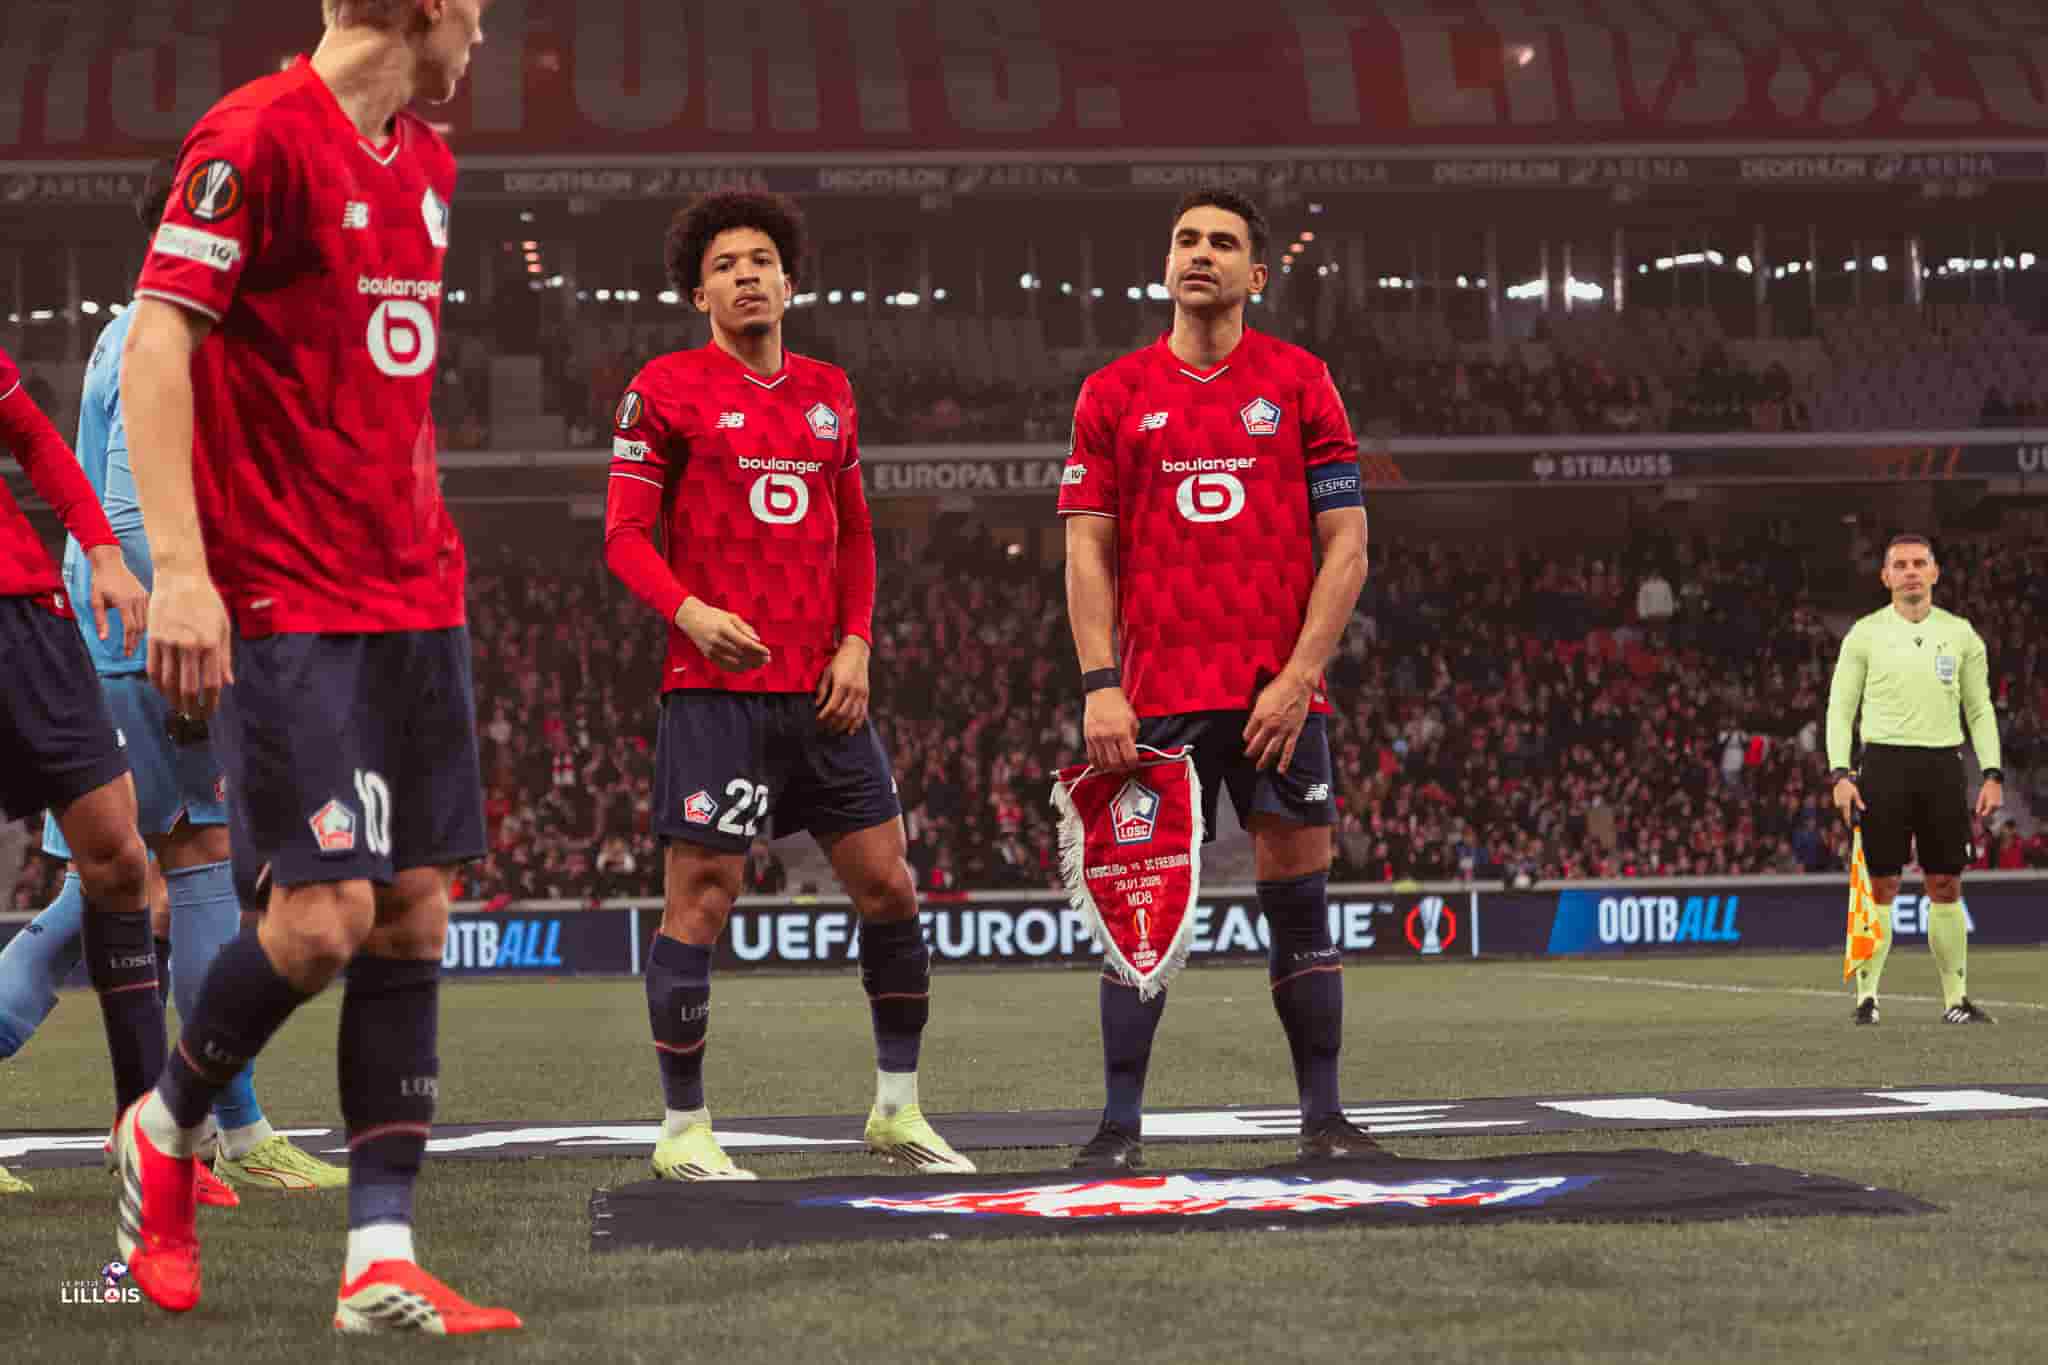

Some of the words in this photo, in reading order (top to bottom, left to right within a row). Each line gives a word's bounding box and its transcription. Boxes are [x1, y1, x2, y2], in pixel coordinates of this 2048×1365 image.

[356, 273, 443, 301] boulanger
[738, 455, 823, 474] boulanger
[1161, 456, 1257, 473] boulanger
[1561, 453, 1672, 479] STRAUSS
[874, 463, 997, 488] EUROPA
[1120, 825, 1148, 839] LOSC
[1127, 890, 1153, 907] MD8
